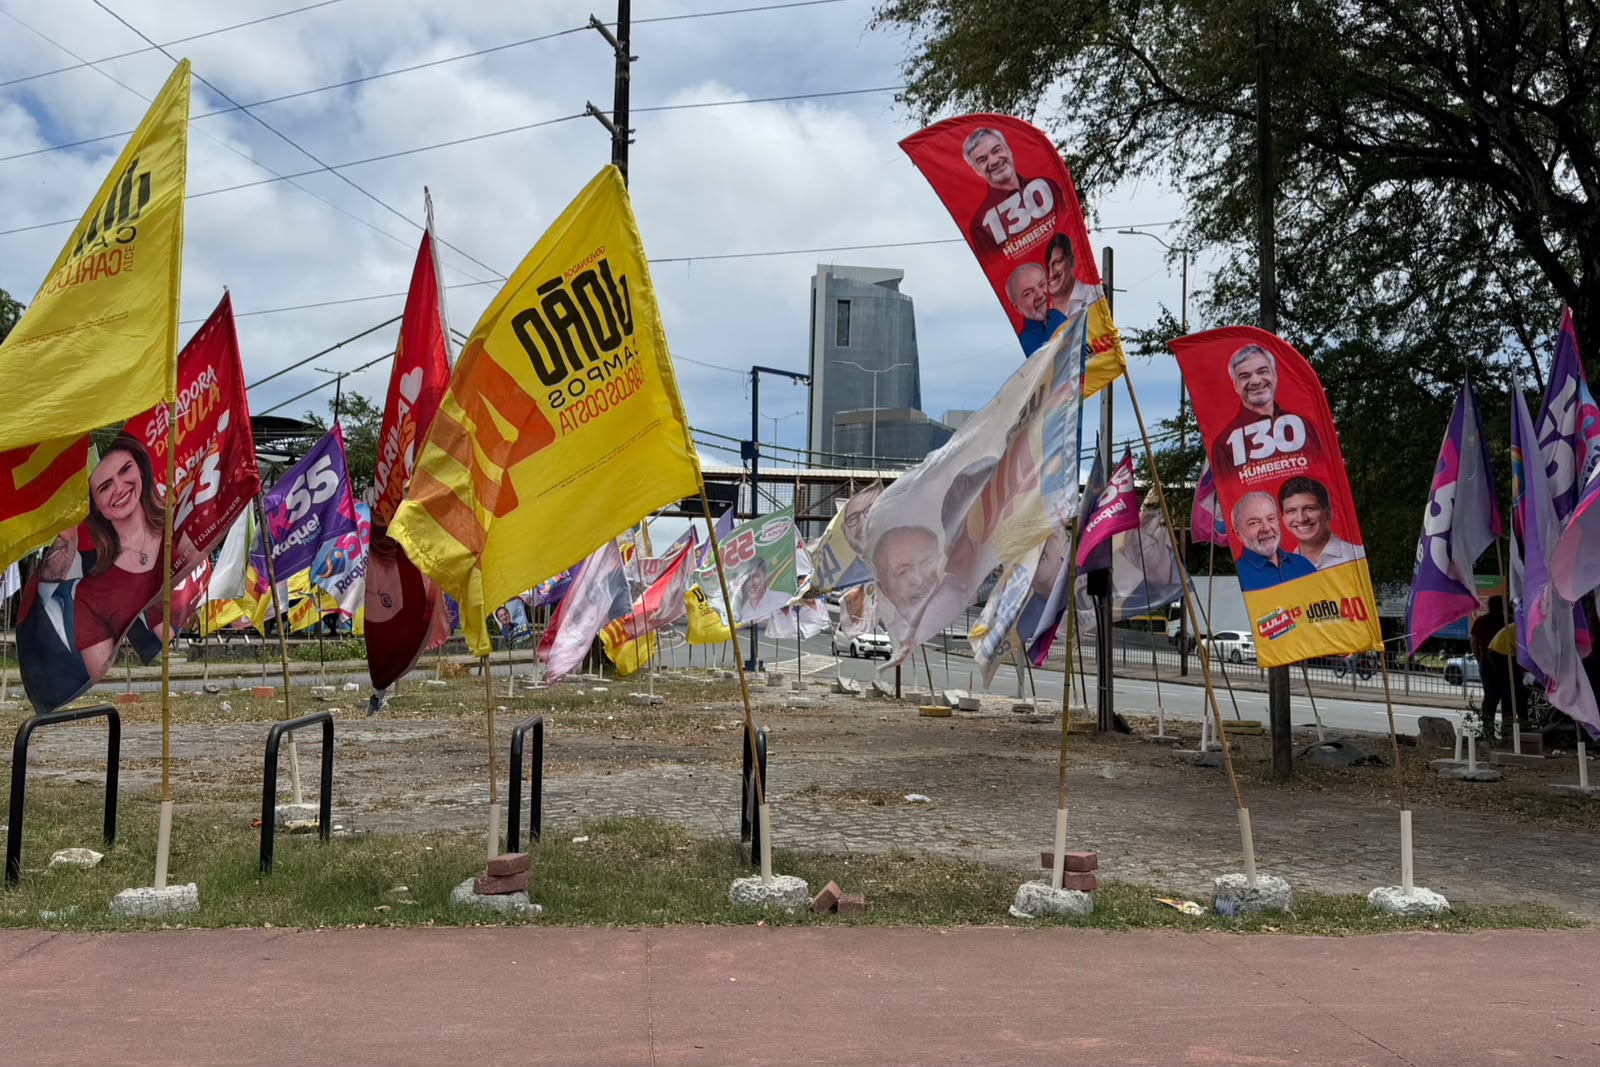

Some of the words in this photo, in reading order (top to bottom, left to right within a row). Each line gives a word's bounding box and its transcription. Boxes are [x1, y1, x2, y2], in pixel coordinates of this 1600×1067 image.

[982, 177, 1054, 246] 130
[174, 381, 221, 446] LULA
[1225, 413, 1307, 468] 130
[153, 447, 195, 484] SENDORA
[380, 412, 417, 527] ARRES
[1238, 456, 1309, 480] HUMBERTO
[1086, 499, 1127, 533] Raquel
[1258, 610, 1291, 634] LULA
[1290, 606, 1303, 621] 13
[1306, 599, 1339, 621] JOÃO
[1340, 596, 1368, 623] 40
